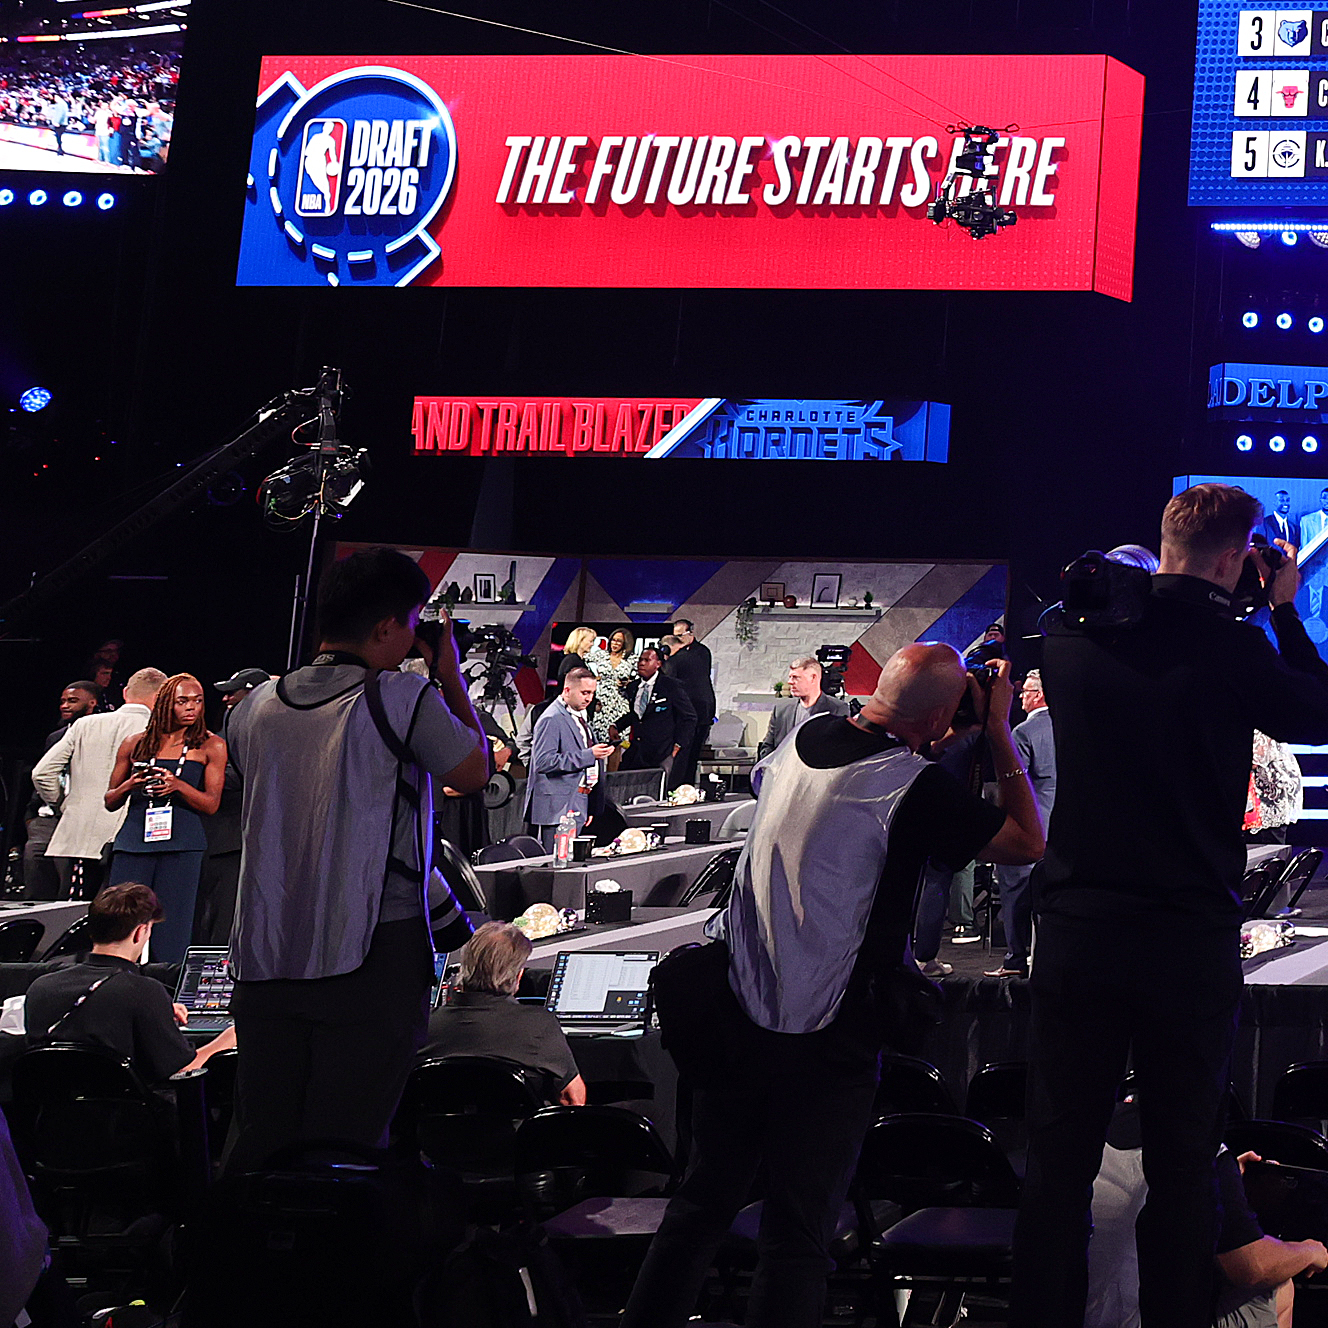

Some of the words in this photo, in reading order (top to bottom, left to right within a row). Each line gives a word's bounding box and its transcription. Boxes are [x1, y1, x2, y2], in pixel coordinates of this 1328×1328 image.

[1251, 15, 1264, 50] 3
[1247, 75, 1261, 110] 4
[349, 118, 440, 168] DRAFT
[1245, 136, 1258, 171] 5
[496, 136, 587, 204] THE
[585, 136, 762, 206] FUTURE
[763, 136, 939, 207] STARTS
[301, 193, 323, 210] NBA
[343, 166, 420, 216] 2026
[476, 402, 566, 452] TRAIL
[745, 410, 858, 423] CHARLOTTE
